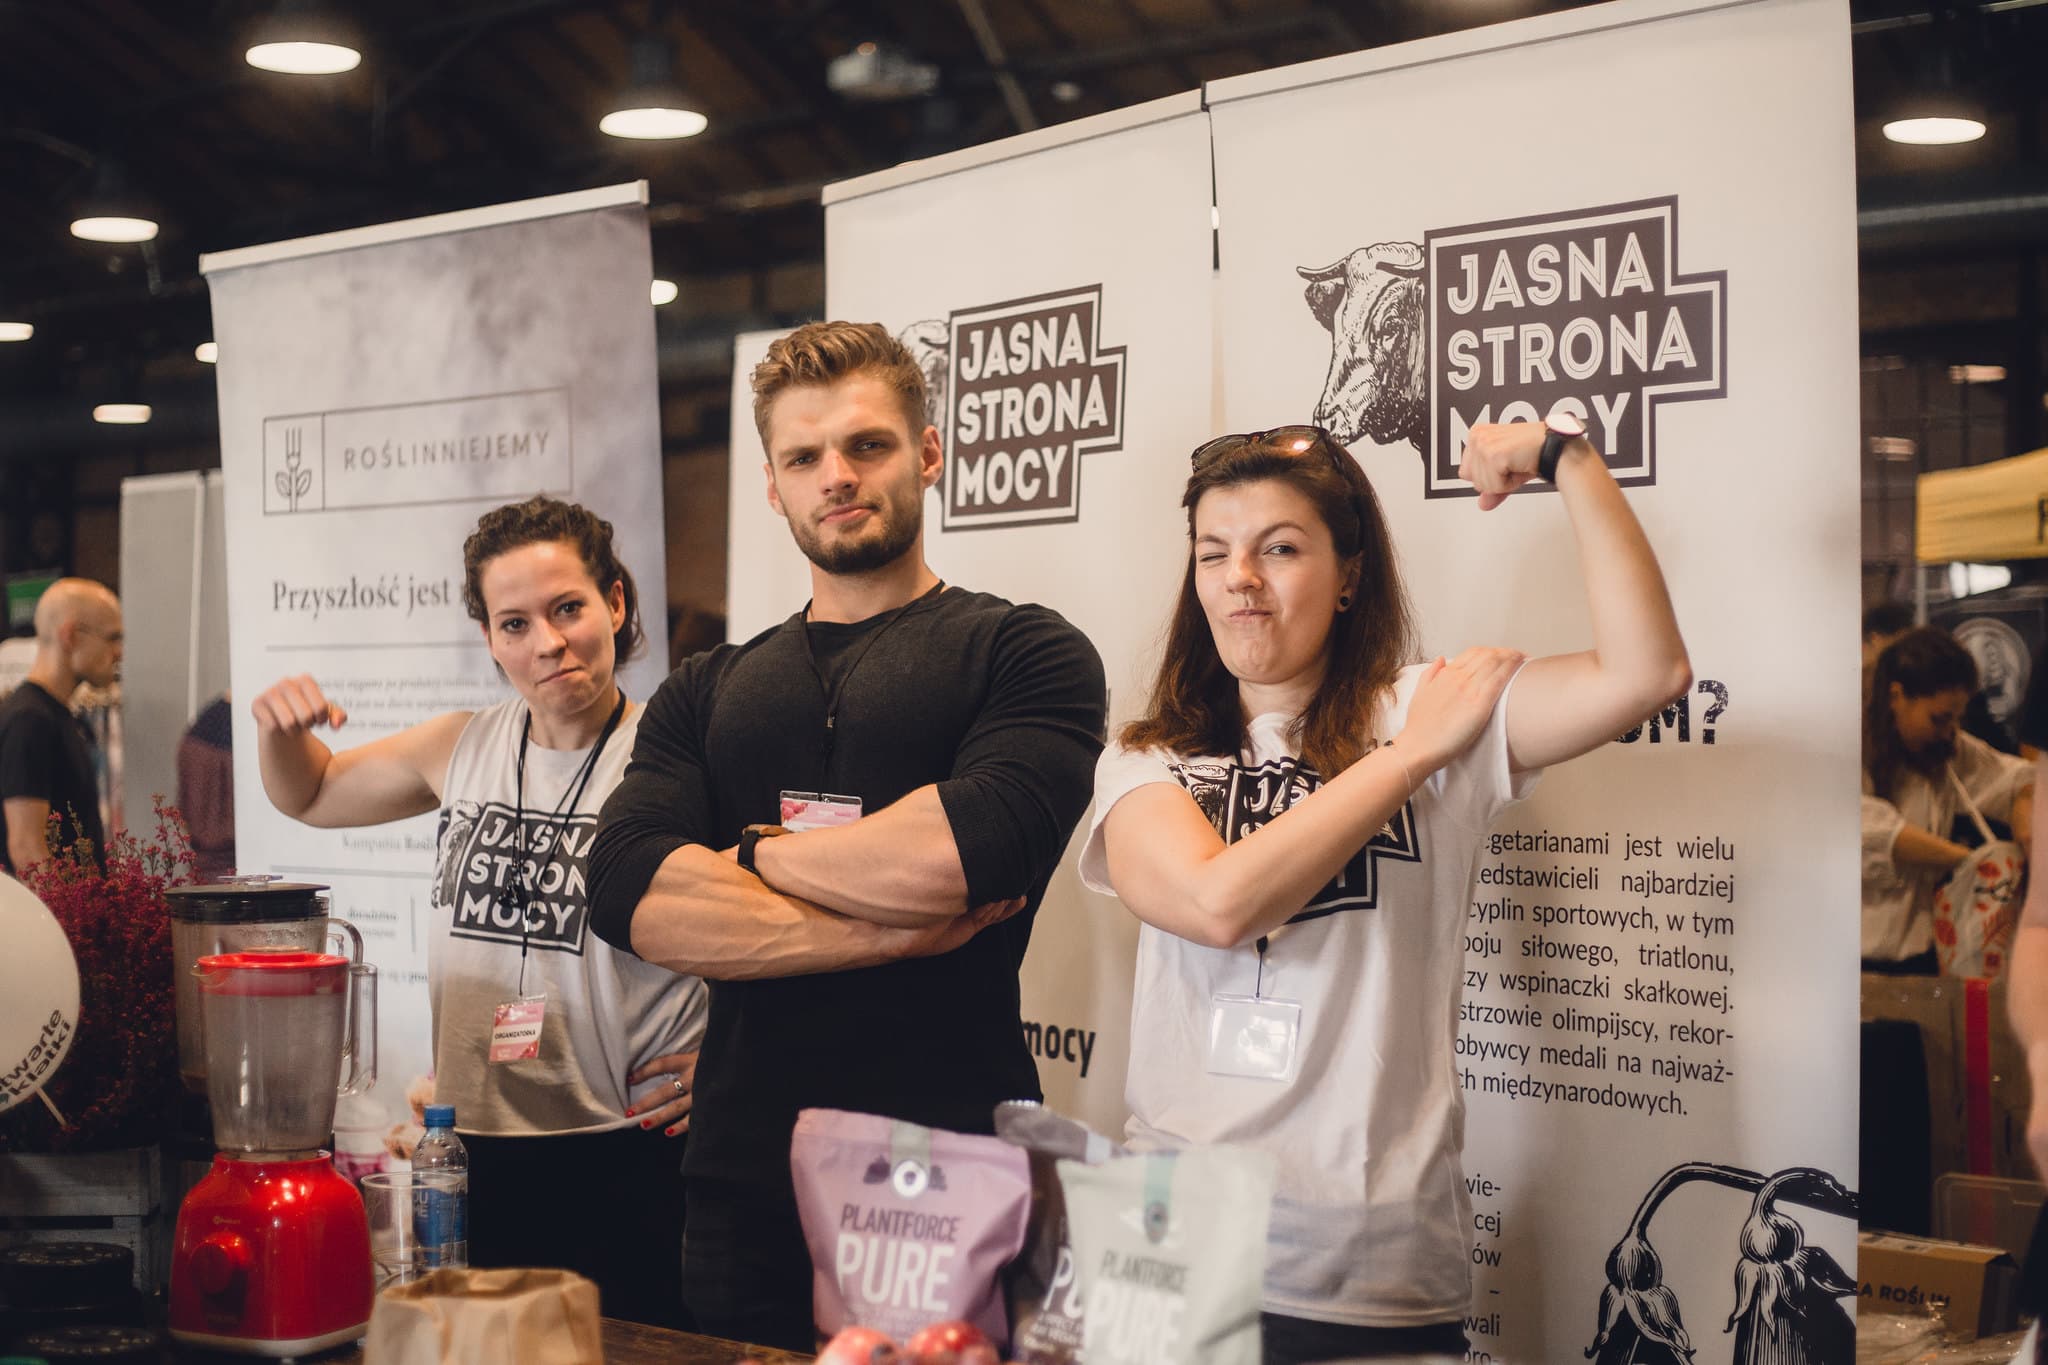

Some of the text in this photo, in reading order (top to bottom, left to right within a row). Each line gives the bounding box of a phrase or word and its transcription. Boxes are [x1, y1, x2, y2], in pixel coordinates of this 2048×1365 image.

[1447, 231, 1654, 315] JASNA
[959, 312, 1087, 382] JASNA
[1447, 306, 1697, 391] STRONA
[957, 373, 1109, 445] STRONA
[343, 430, 550, 473] ROŚLINNIEJEMY
[955, 444, 1068, 507] MOCY
[272, 574, 400, 622] Przyszłość
[405, 574, 450, 618] jest
[1485, 829, 1734, 861] getarianami jest wielu
[1476, 862, 1734, 903] edstawicieli najbardziej
[459, 889, 576, 936] MOCY
[1532, 903, 1659, 934] sportowych,
[1666, 913, 1685, 932] w
[1692, 911, 1734, 939] tym
[1521, 934, 1618, 968] siłowego,
[1638, 943, 1734, 976] triatlonu,
[1463, 970, 1734, 1015] zy wspinaczki skałkowej.
[1552, 1007, 1659, 1044] olimpijscy,
[1670, 1019, 1734, 1046] rekor-
[8, 1019, 71, 1096] klatki
[1540, 1044, 1607, 1070] medali
[1618, 1054, 1641, 1074] na
[1652, 1055, 1734, 1084] najważ-
[1483, 1071, 1688, 1117] międzynarodowych.
[840, 1203, 961, 1243] PLANTFORCE
[1474, 1211, 1502, 1238] cej
[835, 1231, 955, 1313] PURE
[1472, 1242, 1502, 1268] ów
